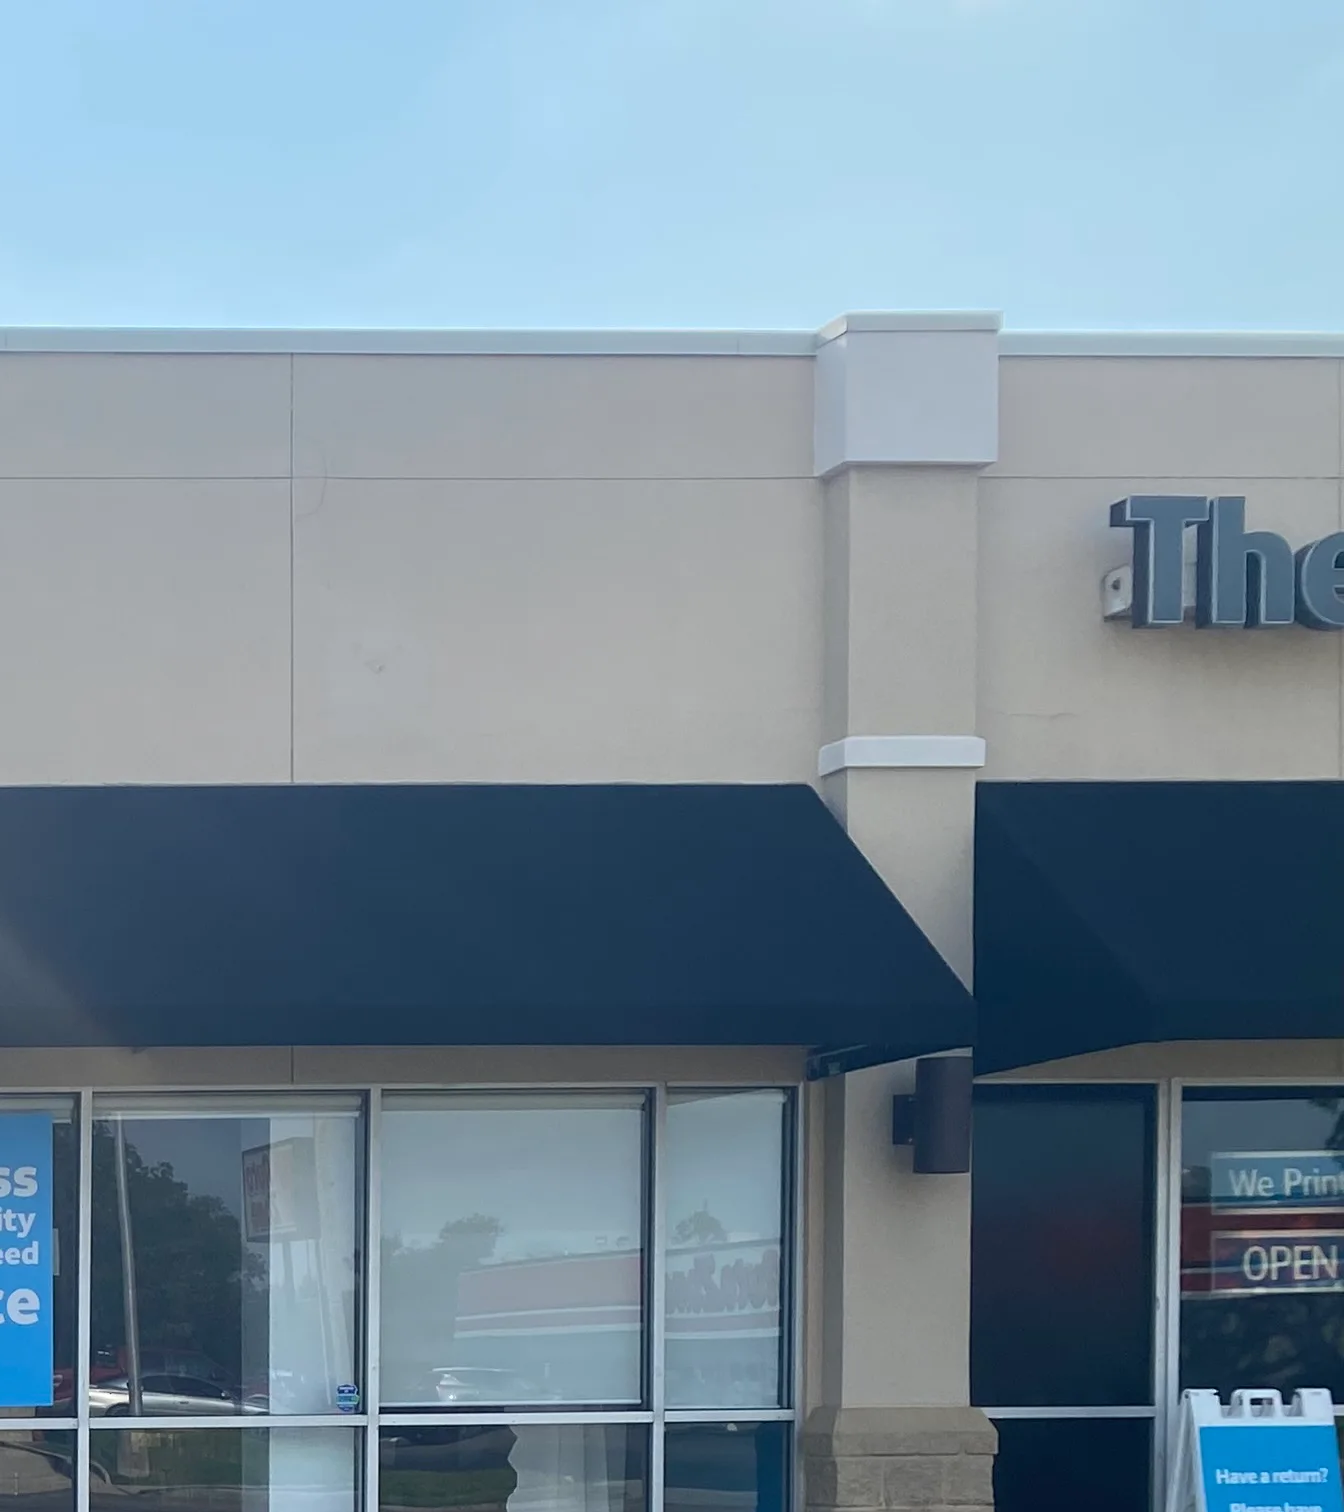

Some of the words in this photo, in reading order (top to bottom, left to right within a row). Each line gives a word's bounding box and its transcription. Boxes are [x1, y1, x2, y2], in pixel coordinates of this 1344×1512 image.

[1228, 1168, 1275, 1197] We
[1243, 1245, 1338, 1281] OPEN
[1216, 1468, 1258, 1484] Have
[1260, 1471, 1270, 1484] a
[1272, 1467, 1328, 1483] return?
